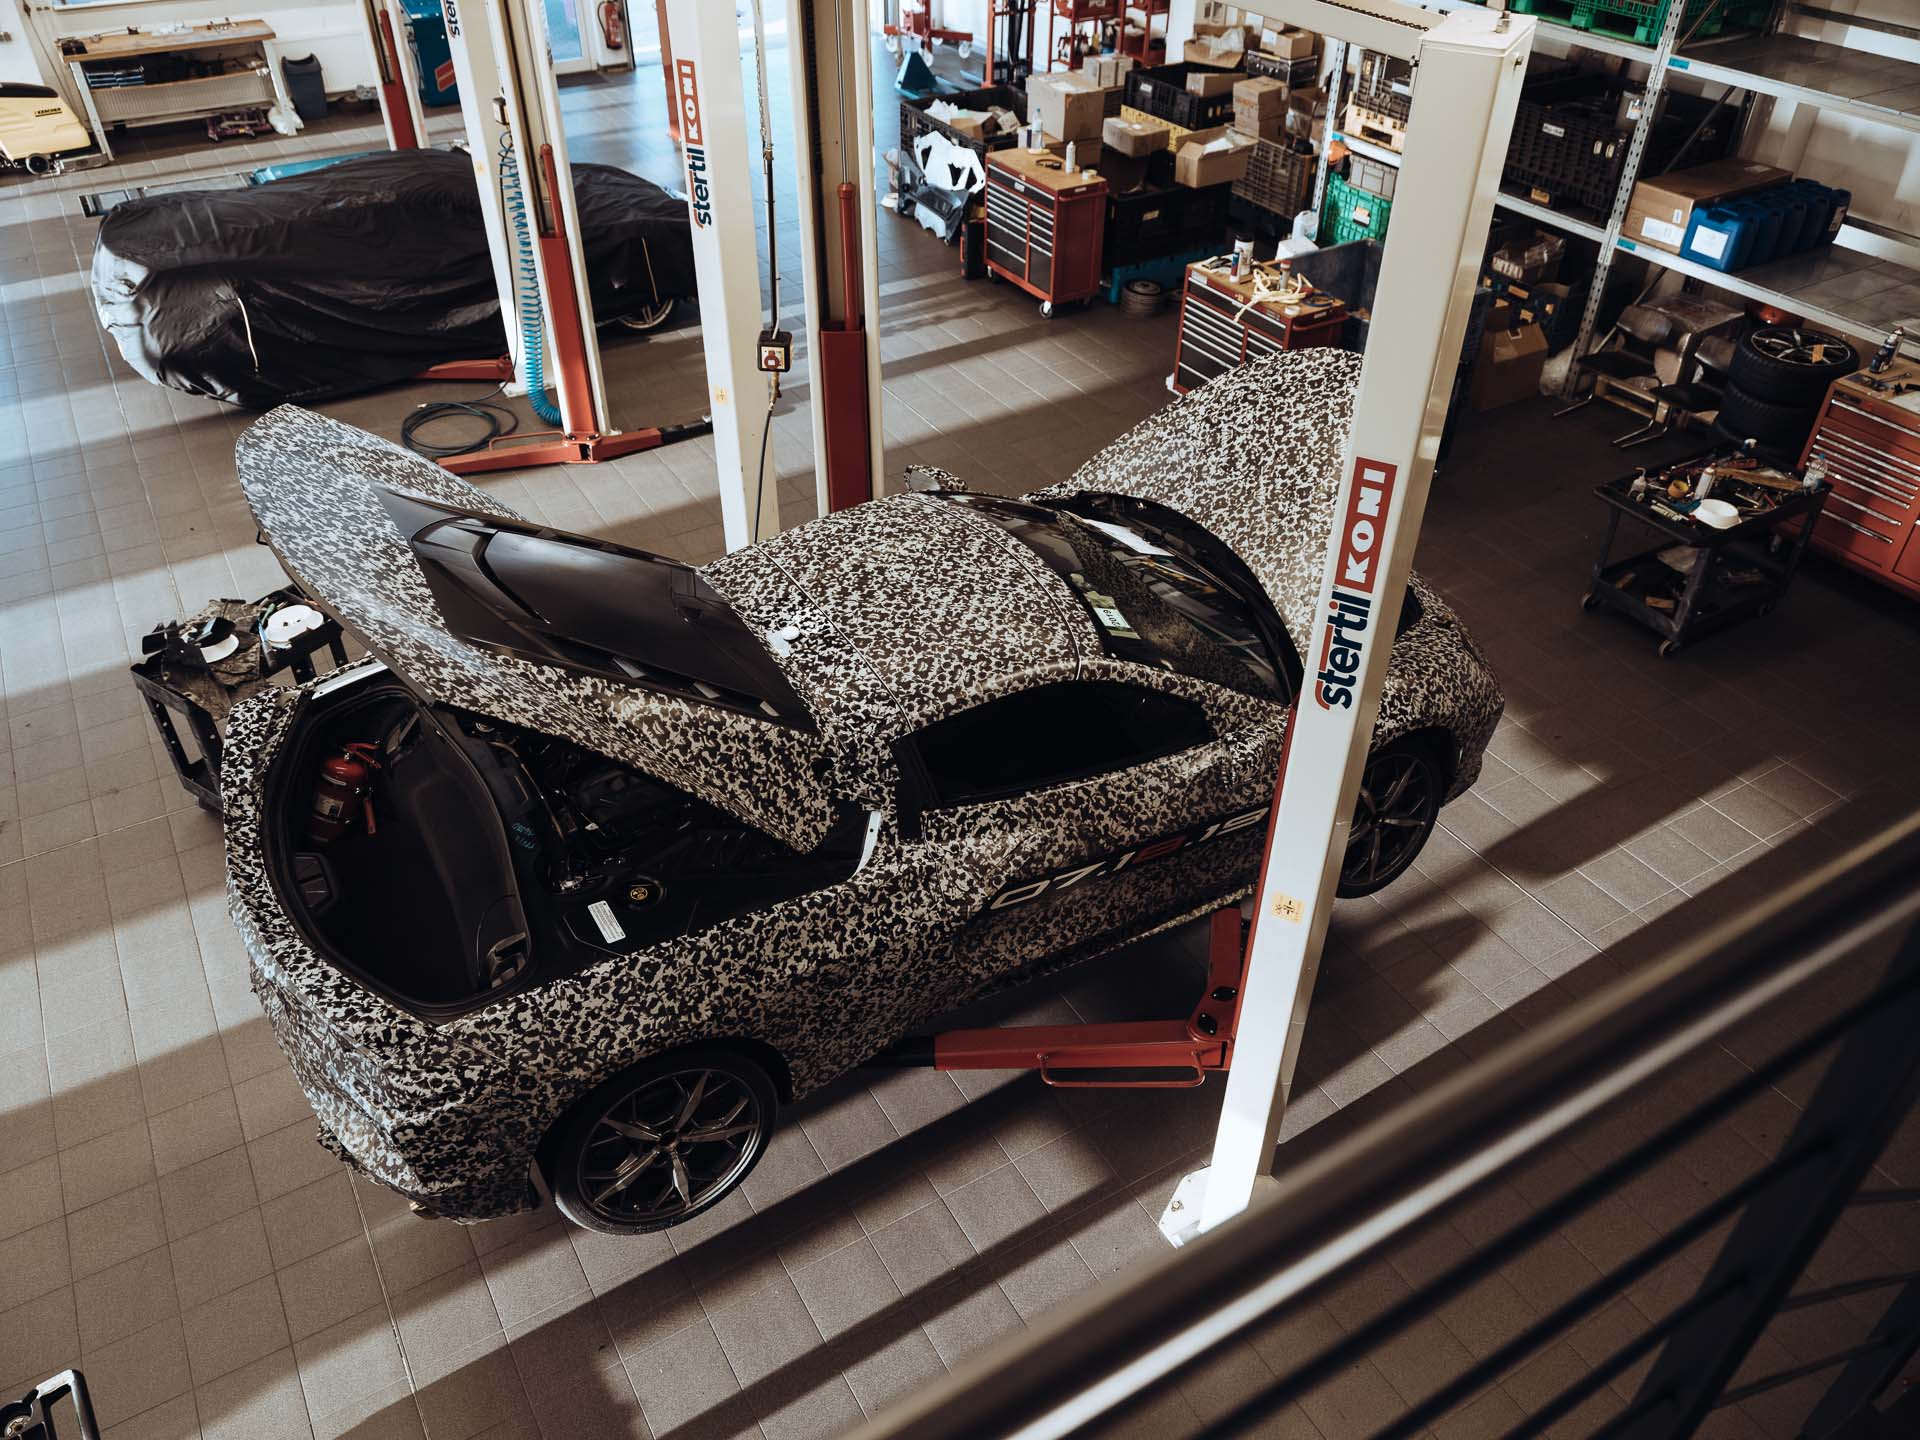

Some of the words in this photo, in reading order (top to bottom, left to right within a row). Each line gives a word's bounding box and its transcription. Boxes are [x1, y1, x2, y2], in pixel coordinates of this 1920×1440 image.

[681, 65, 699, 140] KONI
[686, 147, 712, 228] stertil
[1103, 609, 1121, 625] 2019
[1315, 590, 1372, 710] stertil
[1344, 467, 1386, 584] KONI
[990, 807, 1269, 910] 07.18.19
